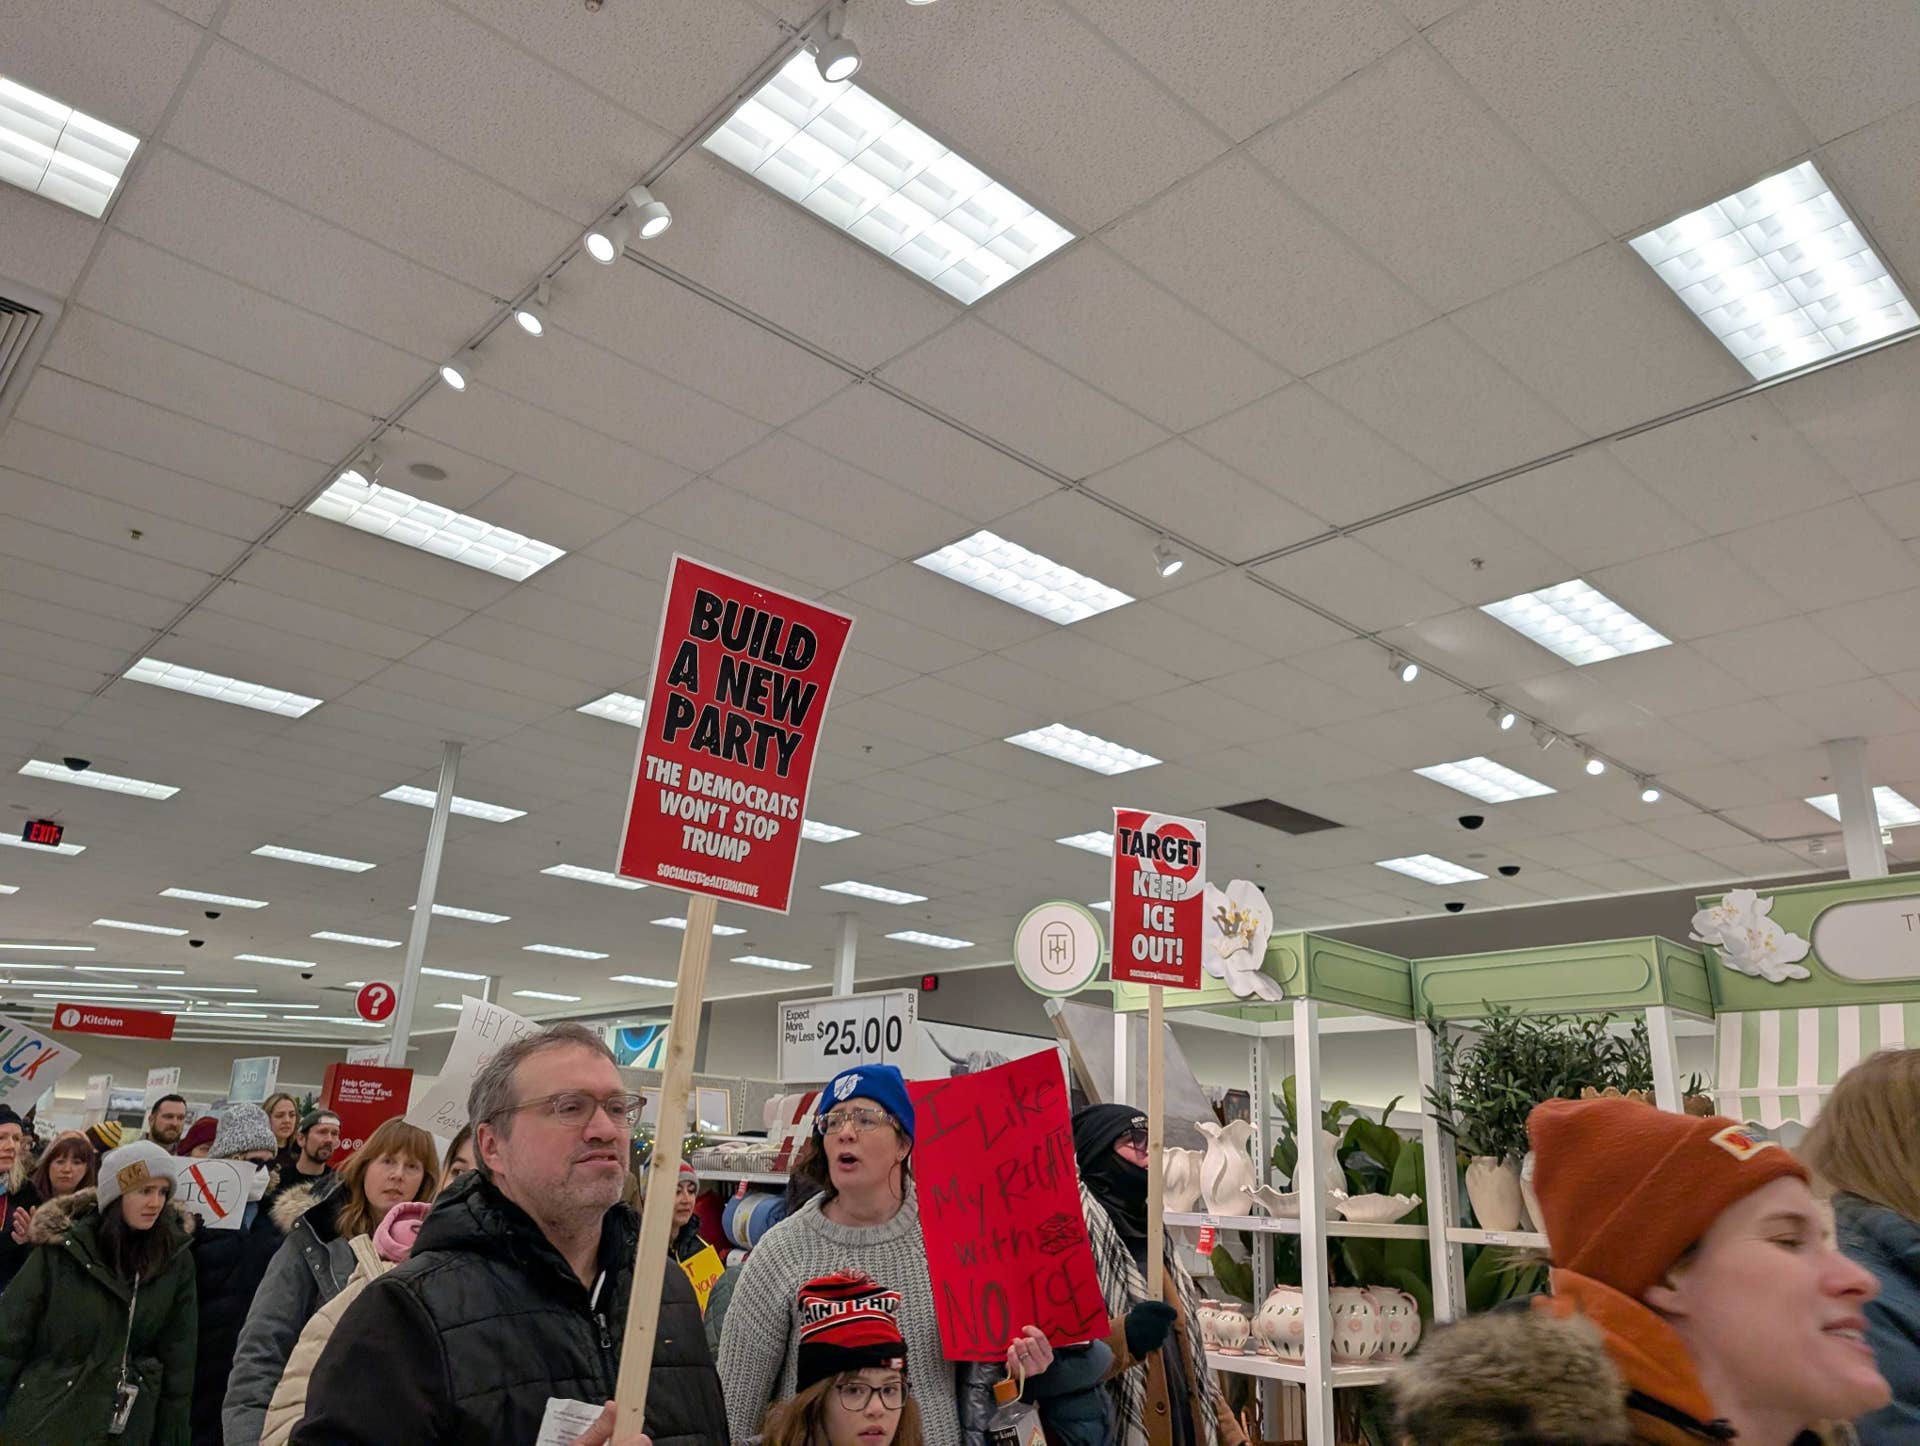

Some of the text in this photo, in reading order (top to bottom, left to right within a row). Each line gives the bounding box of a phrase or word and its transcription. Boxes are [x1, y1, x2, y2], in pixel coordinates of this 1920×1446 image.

[688, 587, 817, 673] BUILD
[666, 640, 818, 727] A NEW
[661, 692, 803, 778] PARTY
[645, 754, 800, 821] THE DEMOCRATS
[659, 789, 780, 843] WON'T STOP
[30, 824, 57, 844] EXIT
[682, 825, 752, 865] TRUMP
[1119, 828, 1202, 867] TARGET
[657, 863, 703, 884] SOCIALIST
[1132, 870, 1188, 902] KEEP
[1142, 904, 1175, 932] ICE
[1131, 934, 1183, 966] OUT!
[82, 1013, 124, 1027] Kitchen
[471, 1005, 510, 1042] HEY
[785, 1021, 804, 1032] More.
[786, 1009, 810, 1021] Expect
[0, 1023, 60, 1081] UCK
[785, 1032, 815, 1044] Pay Less
[816, 1015, 902, 1056] $25.00
[342, 1078, 383, 1089] Help Center
[912, 1083, 971, 1147] I
[181, 1179, 228, 1205] ICE
[853, 1297, 900, 1314] PAU
[943, 1251, 1102, 1349] NO ICE
